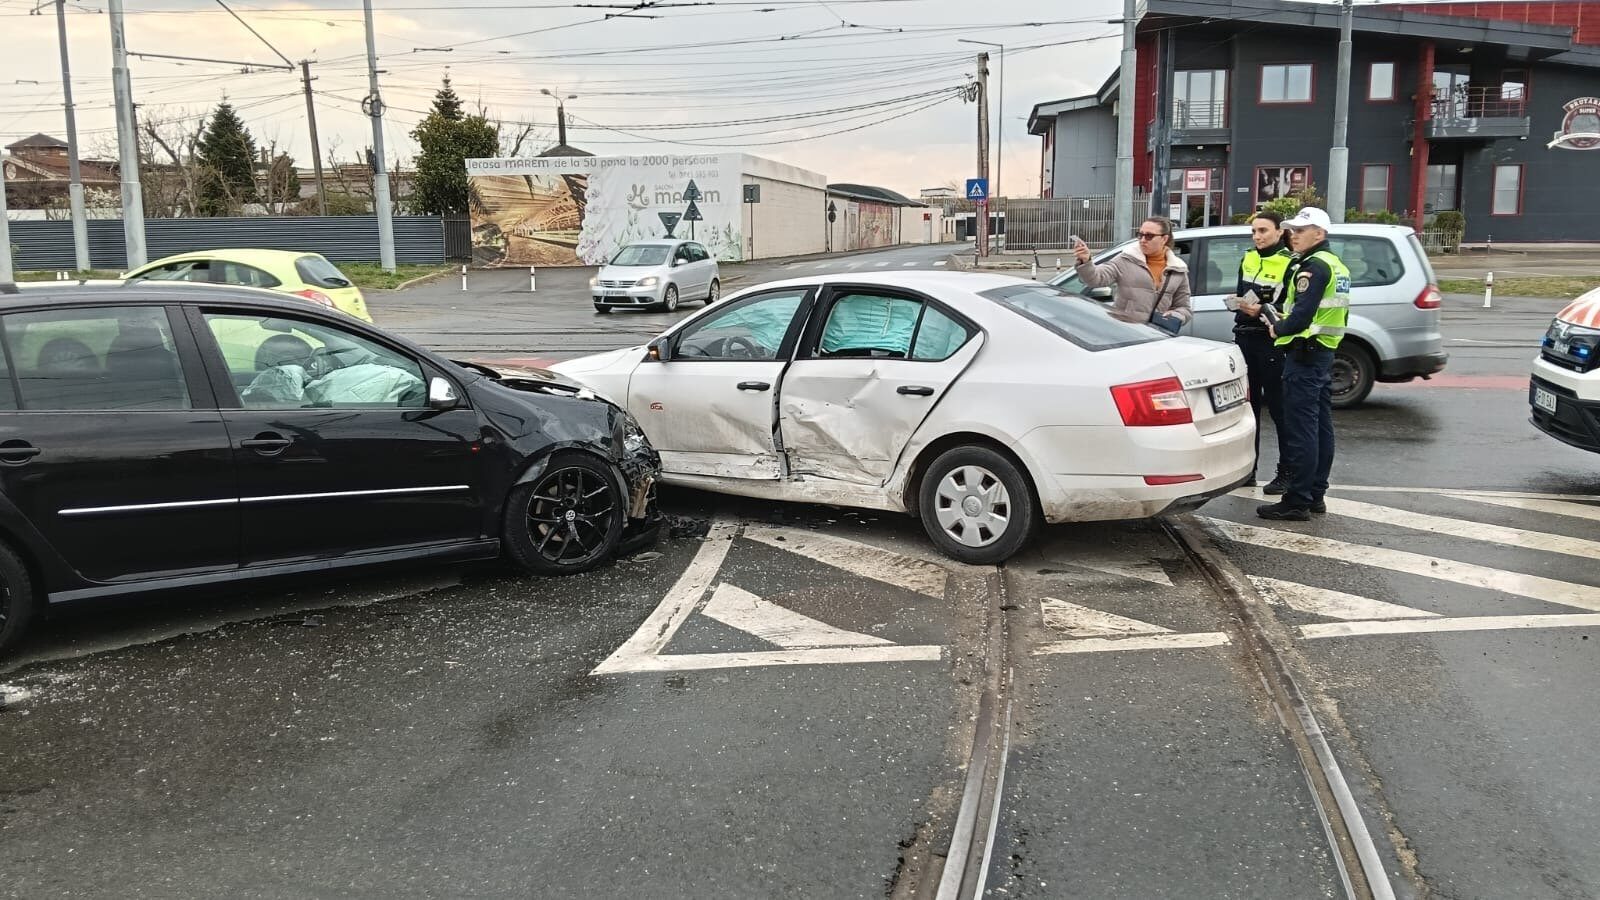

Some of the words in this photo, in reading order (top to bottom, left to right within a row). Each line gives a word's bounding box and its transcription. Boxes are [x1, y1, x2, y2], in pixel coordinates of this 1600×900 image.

[554, 158, 567, 168] de
[570, 158, 580, 167] la
[584, 157, 597, 167] 50
[629, 156, 639, 166] la
[642, 156, 669, 166] 2000
[655, 190, 720, 204] MAM
